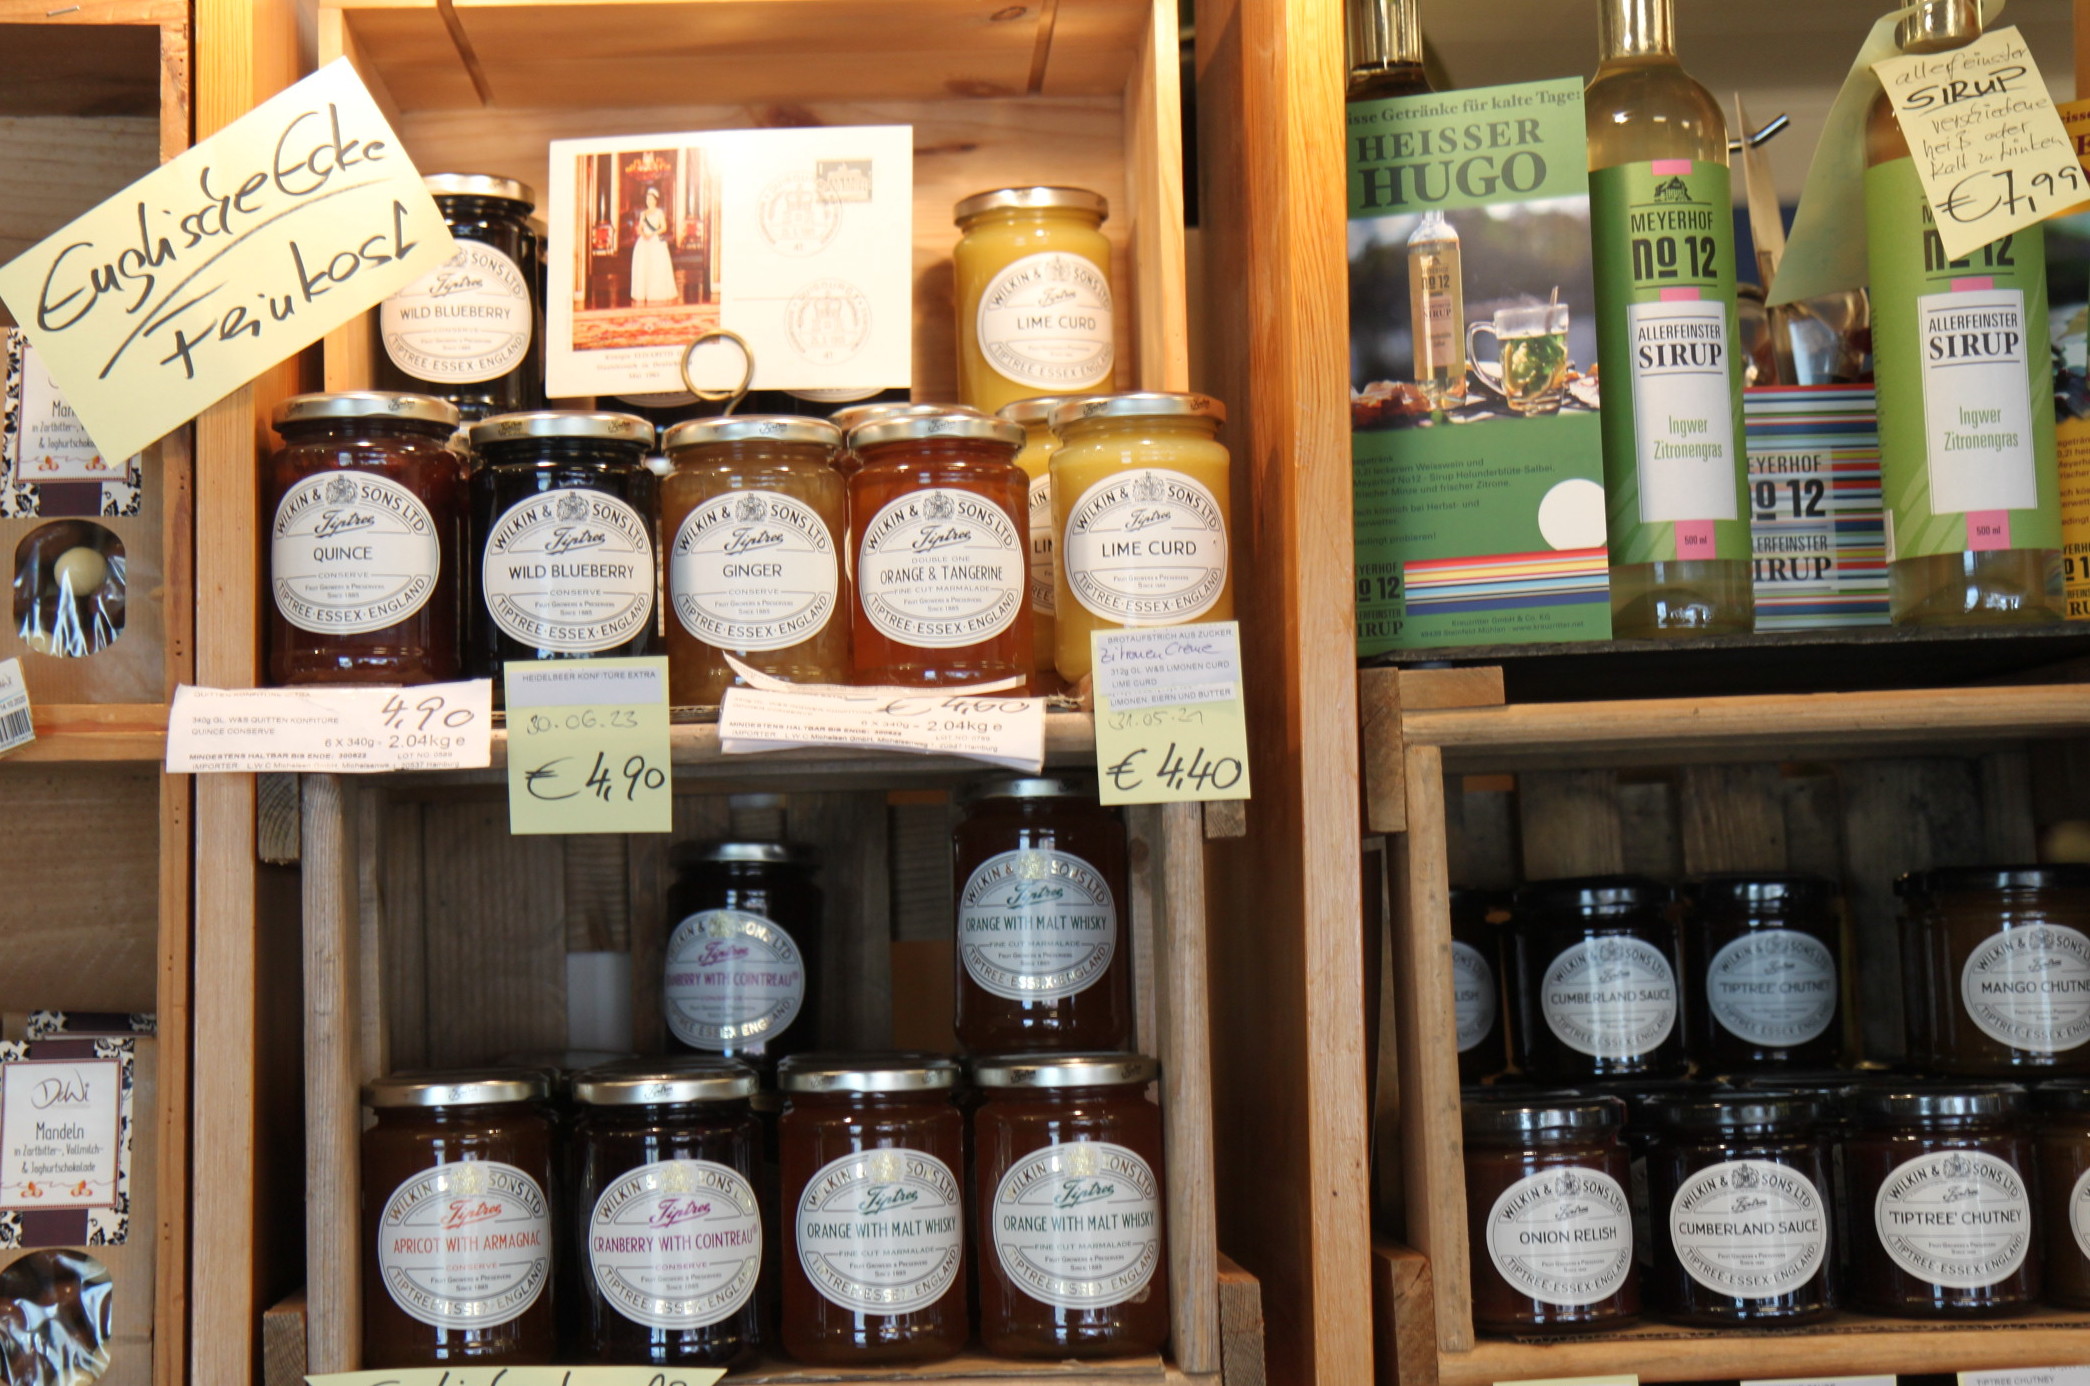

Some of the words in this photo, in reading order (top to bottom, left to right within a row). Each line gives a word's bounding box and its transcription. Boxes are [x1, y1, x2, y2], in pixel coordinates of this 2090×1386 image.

[1902, 65, 2026, 110] SIRUP
[1382, 103, 1458, 122] Getränke
[1463, 99, 1488, 112] für
[1492, 94, 1532, 110] kalte
[1536, 89, 1581, 107] Tage:
[275, 103, 386, 195] Ecke
[1356, 118, 1544, 163] HEISSER
[1358, 151, 1547, 209] HUGO
[1631, 210, 1713, 233] MEYERHOF
[142, 199, 419, 380] Feinkost
[401, 307, 431, 320] WILD
[435, 307, 511, 320] BLUEBERRY
[1017, 318, 1052, 330] LIME
[1058, 316, 1096, 330] CURD
[1929, 313, 2017, 333] ALLERFEINSTER
[1638, 324, 1720, 342] ALLERFEINSTER
[1639, 343, 1722, 368] SIRUP
[1929, 332, 2019, 360] SIRUP
[1669, 415, 1708, 437] Ingwer
[1960, 406, 2001, 429] Ingwer
[1654, 440, 1722, 461] Zitronengras
[1944, 432, 2018, 451] Zitronengras
[277, 492, 311, 533] WILKIN
[313, 489, 321, 500] &
[362, 486, 402, 510] SONS
[402, 506, 425, 532] LTD
[495, 509, 537, 549] WILKIN
[543, 505, 551, 517] &
[593, 504, 626, 528] SONS
[628, 522, 643, 549] LTD
[1977, 527, 1990, 536] 500
[1102, 541, 1141, 557] LIME
[1148, 541, 1197, 555] CURD
[1685, 535, 1698, 545] 500
[313, 547, 373, 562] QUINCE
[509, 565, 546, 579] WILD
[552, 564, 634, 578] BLUEBERRY
[723, 563, 782, 578] GINGER
[880, 566, 923, 585] ORANGE
[929, 567, 936, 580] &
[943, 566, 1002, 581] TANGERINE
[279, 583, 313, 618] TIPTREE
[317, 610, 362, 622] ESSEX
[369, 578, 425, 618] ENGLAND
[497, 599, 546, 635] TIPTREE
[549, 627, 595, 639] ESSEX
[602, 597, 645, 636] ENGLAND
[1180, 631, 1196, 639] AUS
[1200, 629, 1232, 638] ZUCKER
[1206, 661, 1229, 669] CURD
[523, 671, 575, 682] HEIDELBEER
[628, 670, 655, 679] EXTRA
[1112, 680, 1130, 688] LIME
[1134, 679, 1157, 687] CURD
[1179, 692, 1196, 700] UND
[1199, 689, 1230, 698] BUTTER
[966, 916, 1000, 932] ORANGE
[1004, 916, 1032, 931] WITH
[1037, 916, 1066, 930] MALT
[1071, 915, 1106, 931] WHISKY
[1551, 991, 1636, 1004] CUMBERLAND
[1640, 988, 1670, 1000] SAUCE
[1982, 981, 2037, 994] MANGO
[36, 1122, 84, 1140] Mandeln
[1682, 1179, 1716, 1210] WILKIN
[1720, 1177, 1727, 1186] &
[1762, 1174, 1793, 1193] SONS
[1793, 1188, 1811, 1208] LTD
[1004, 1216, 1046, 1232] ORANGE
[1052, 1216, 1083, 1232] WITH
[1088, 1214, 1118, 1230] MALT
[1122, 1211, 1154, 1228] WHISKY
[1962, 1209, 2022, 1224] CHUTNEY
[807, 1223, 850, 1238] ORANGE
[857, 1222, 887, 1238] WITH
[892, 1220, 922, 1236] MALT
[925, 1216, 955, 1234] WHISKY
[1520, 1231, 1570, 1245] ONION
[1575, 1227, 1616, 1242] RELISH
[1679, 1222, 1774, 1236] CUMBERLAND
[1779, 1219, 1818, 1233] SAUCE
[394, 1238, 440, 1254] APRICOT
[446, 1236, 478, 1252] WITH
[484, 1230, 540, 1250] ARMAGNAC
[594, 1237, 653, 1253] CRANBERRY
[659, 1235, 691, 1251] WITH
[1686, 1250, 1725, 1280] TIPTREE
[1730, 1276, 1771, 1286] ESSEX
[1774, 1246, 1815, 1282] ENGLAND
